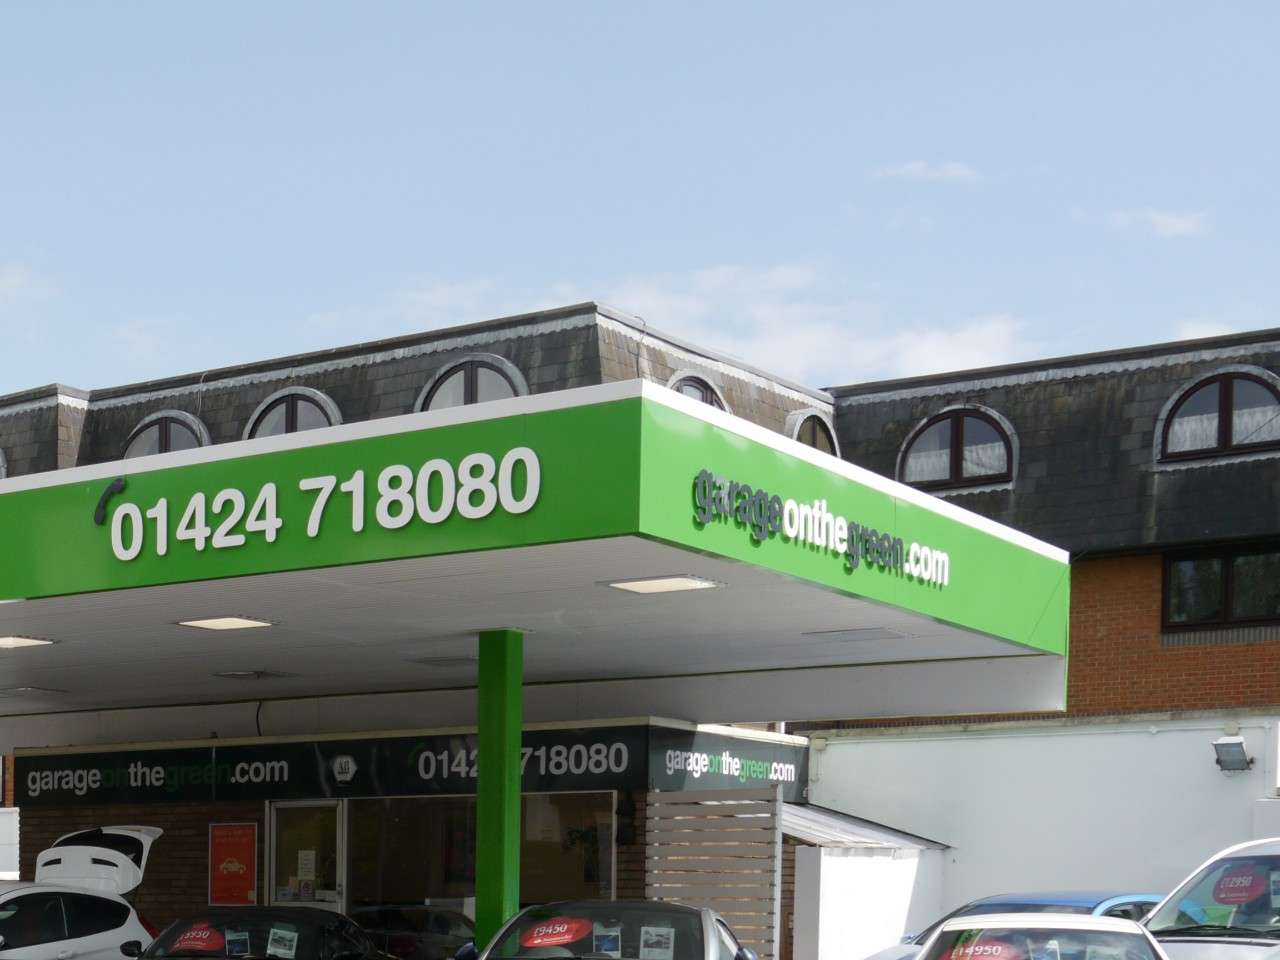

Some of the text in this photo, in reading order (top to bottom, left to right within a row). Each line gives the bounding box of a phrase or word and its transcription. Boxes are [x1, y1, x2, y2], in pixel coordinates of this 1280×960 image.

[111, 446, 541, 561] 01424 718080
[693, 469, 949, 586] garageonthegreen.com
[418, 749, 480, 780] 0142
[666, 749, 795, 783] garageonthegreen.com
